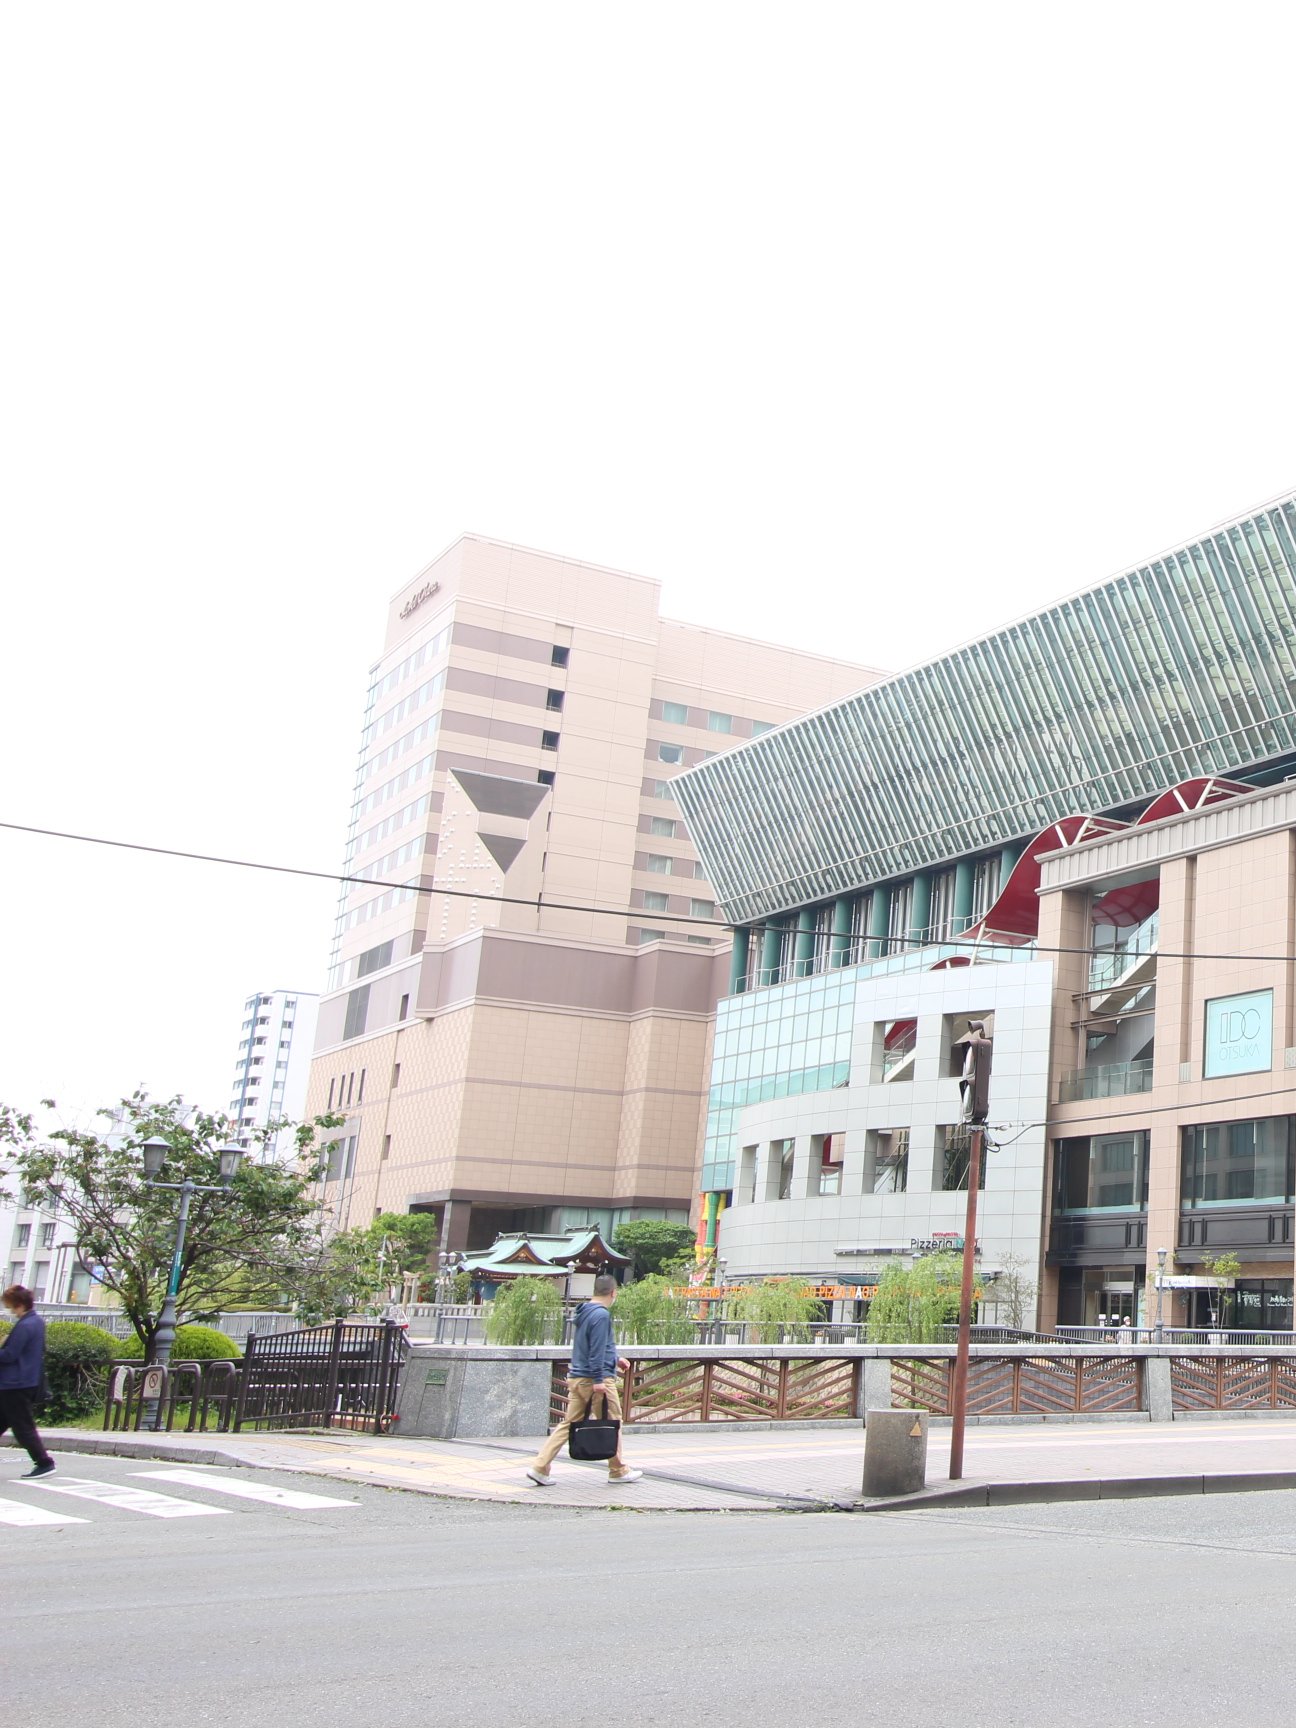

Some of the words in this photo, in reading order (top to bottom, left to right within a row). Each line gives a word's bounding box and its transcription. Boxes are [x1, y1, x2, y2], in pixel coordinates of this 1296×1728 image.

[1220, 1008, 1261, 1044] IDC
[1218, 1044, 1260, 1061] OTSUKA
[910, 1238, 953, 1250] Pizzeria
